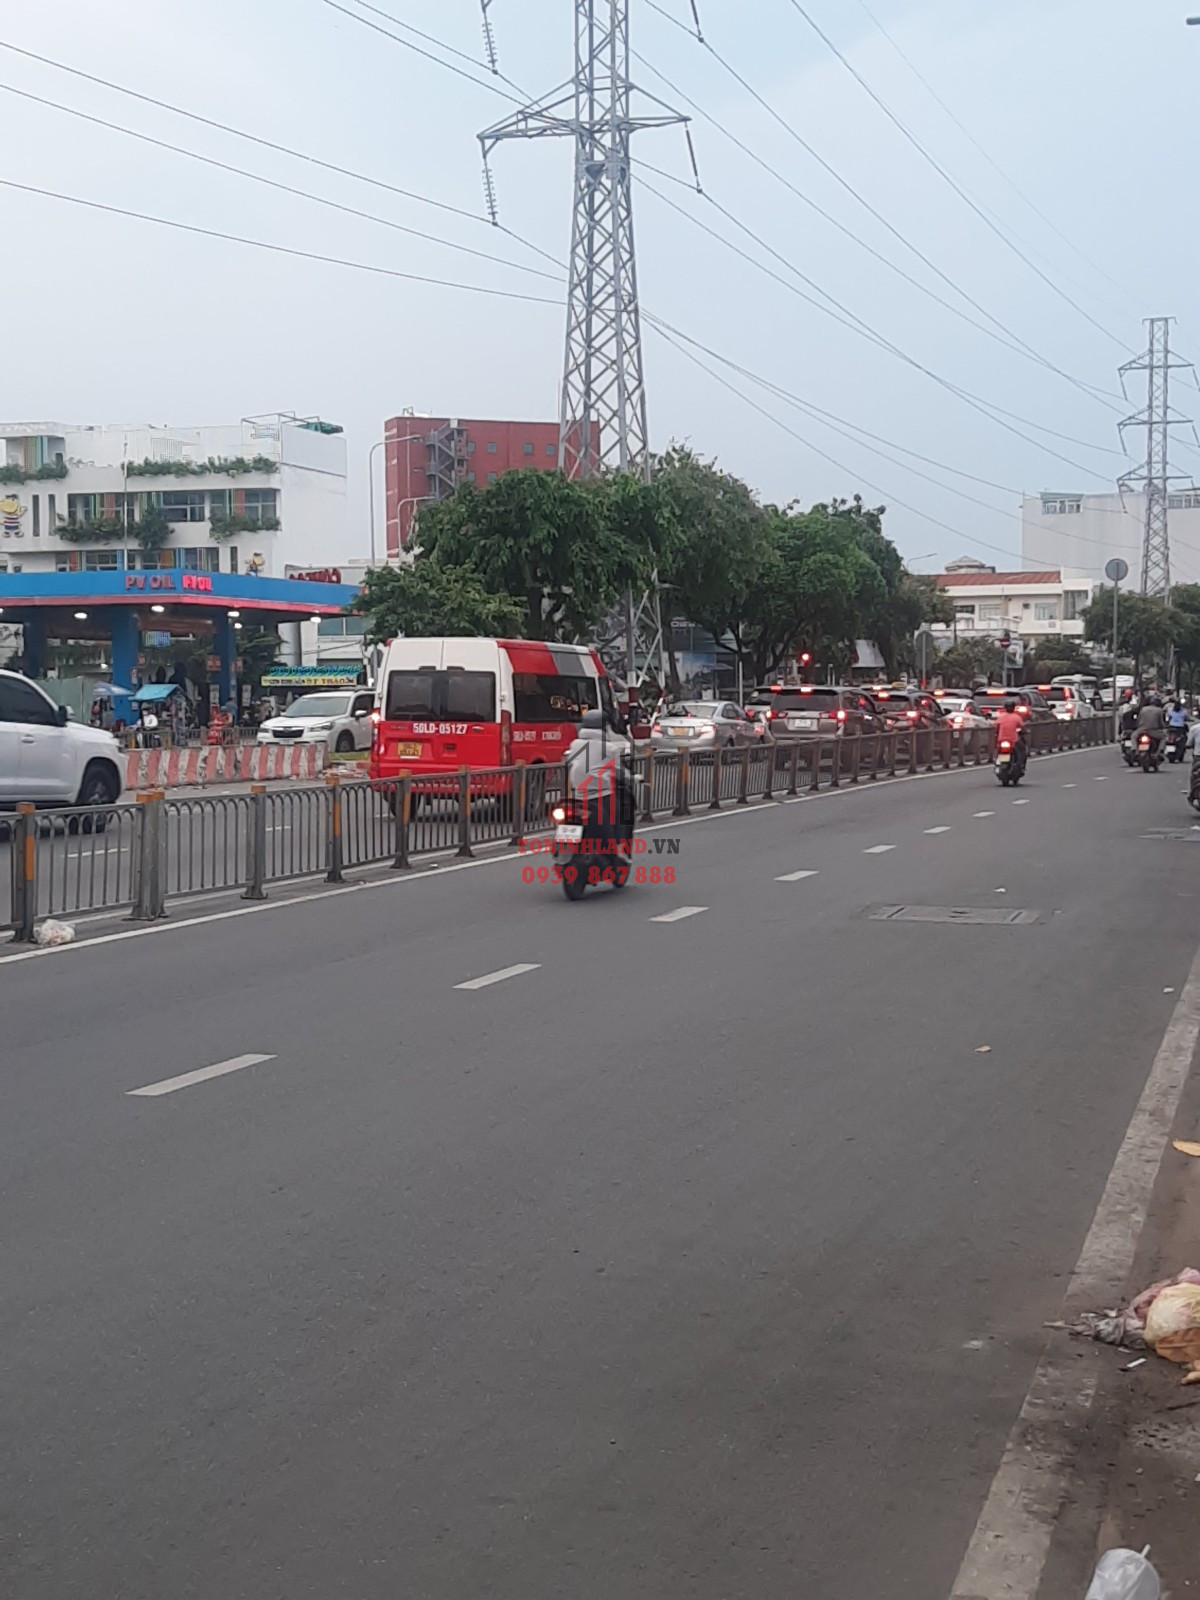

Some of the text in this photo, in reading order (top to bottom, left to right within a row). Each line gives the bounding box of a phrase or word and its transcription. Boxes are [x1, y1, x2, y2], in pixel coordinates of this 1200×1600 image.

[126, 575, 176, 590] PV OIL
[183, 574, 213, 592] PV OIL
